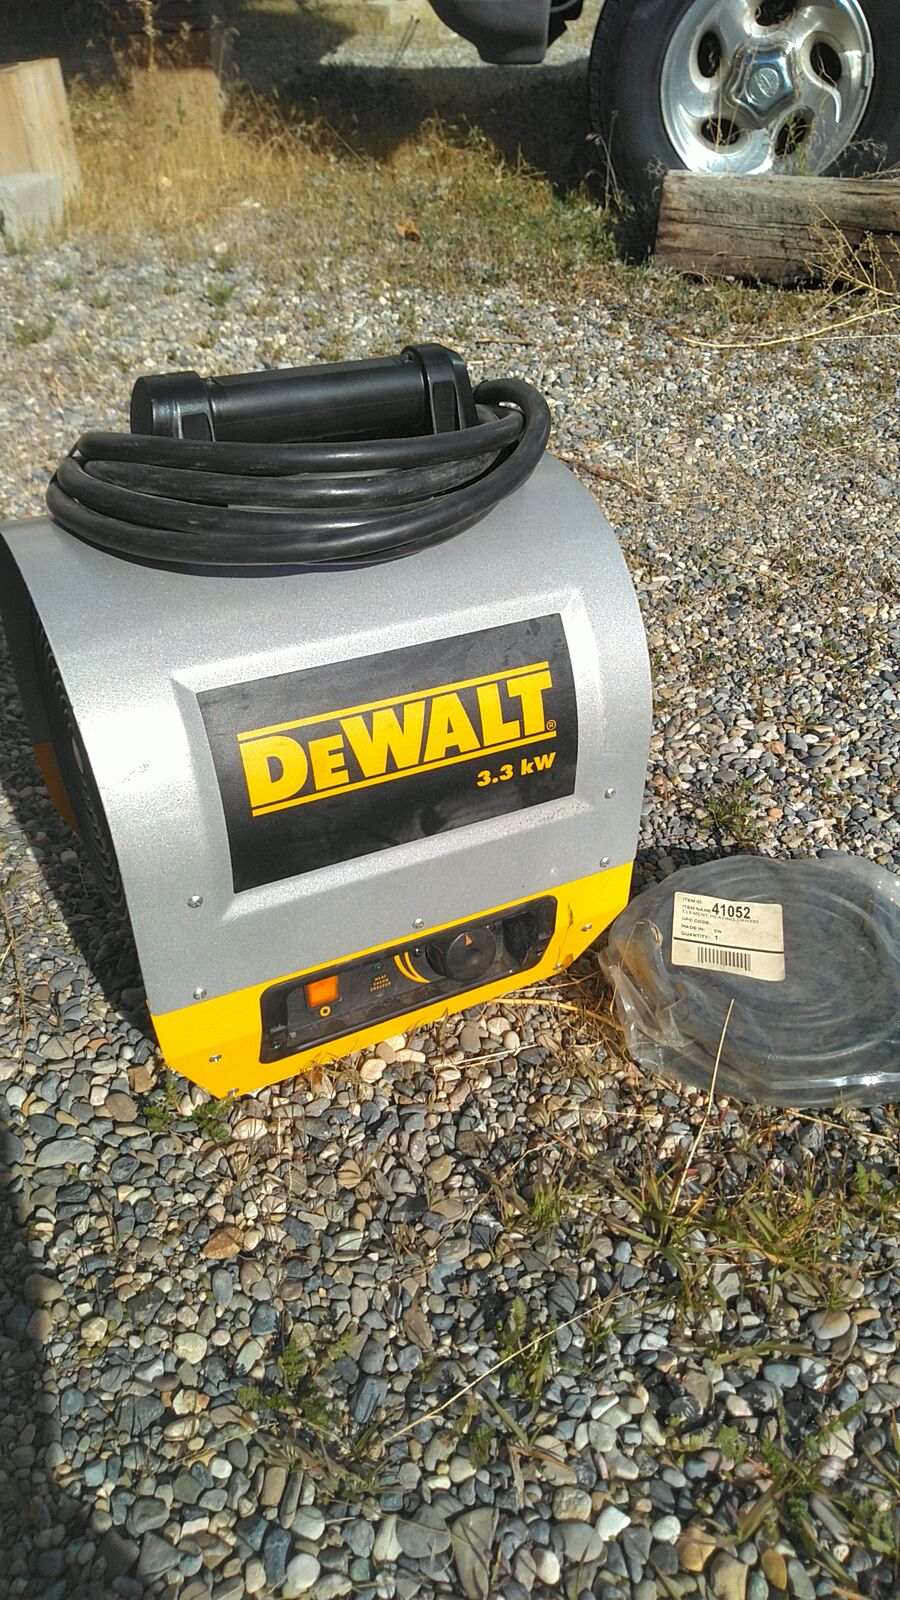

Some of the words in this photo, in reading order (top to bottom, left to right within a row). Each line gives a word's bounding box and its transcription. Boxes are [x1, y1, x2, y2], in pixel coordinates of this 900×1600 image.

[239, 671, 553, 808] DEWALT
[477, 764, 514, 787] 3.3
[521, 751, 557, 776] kW
[711, 903, 751, 919] 41052
